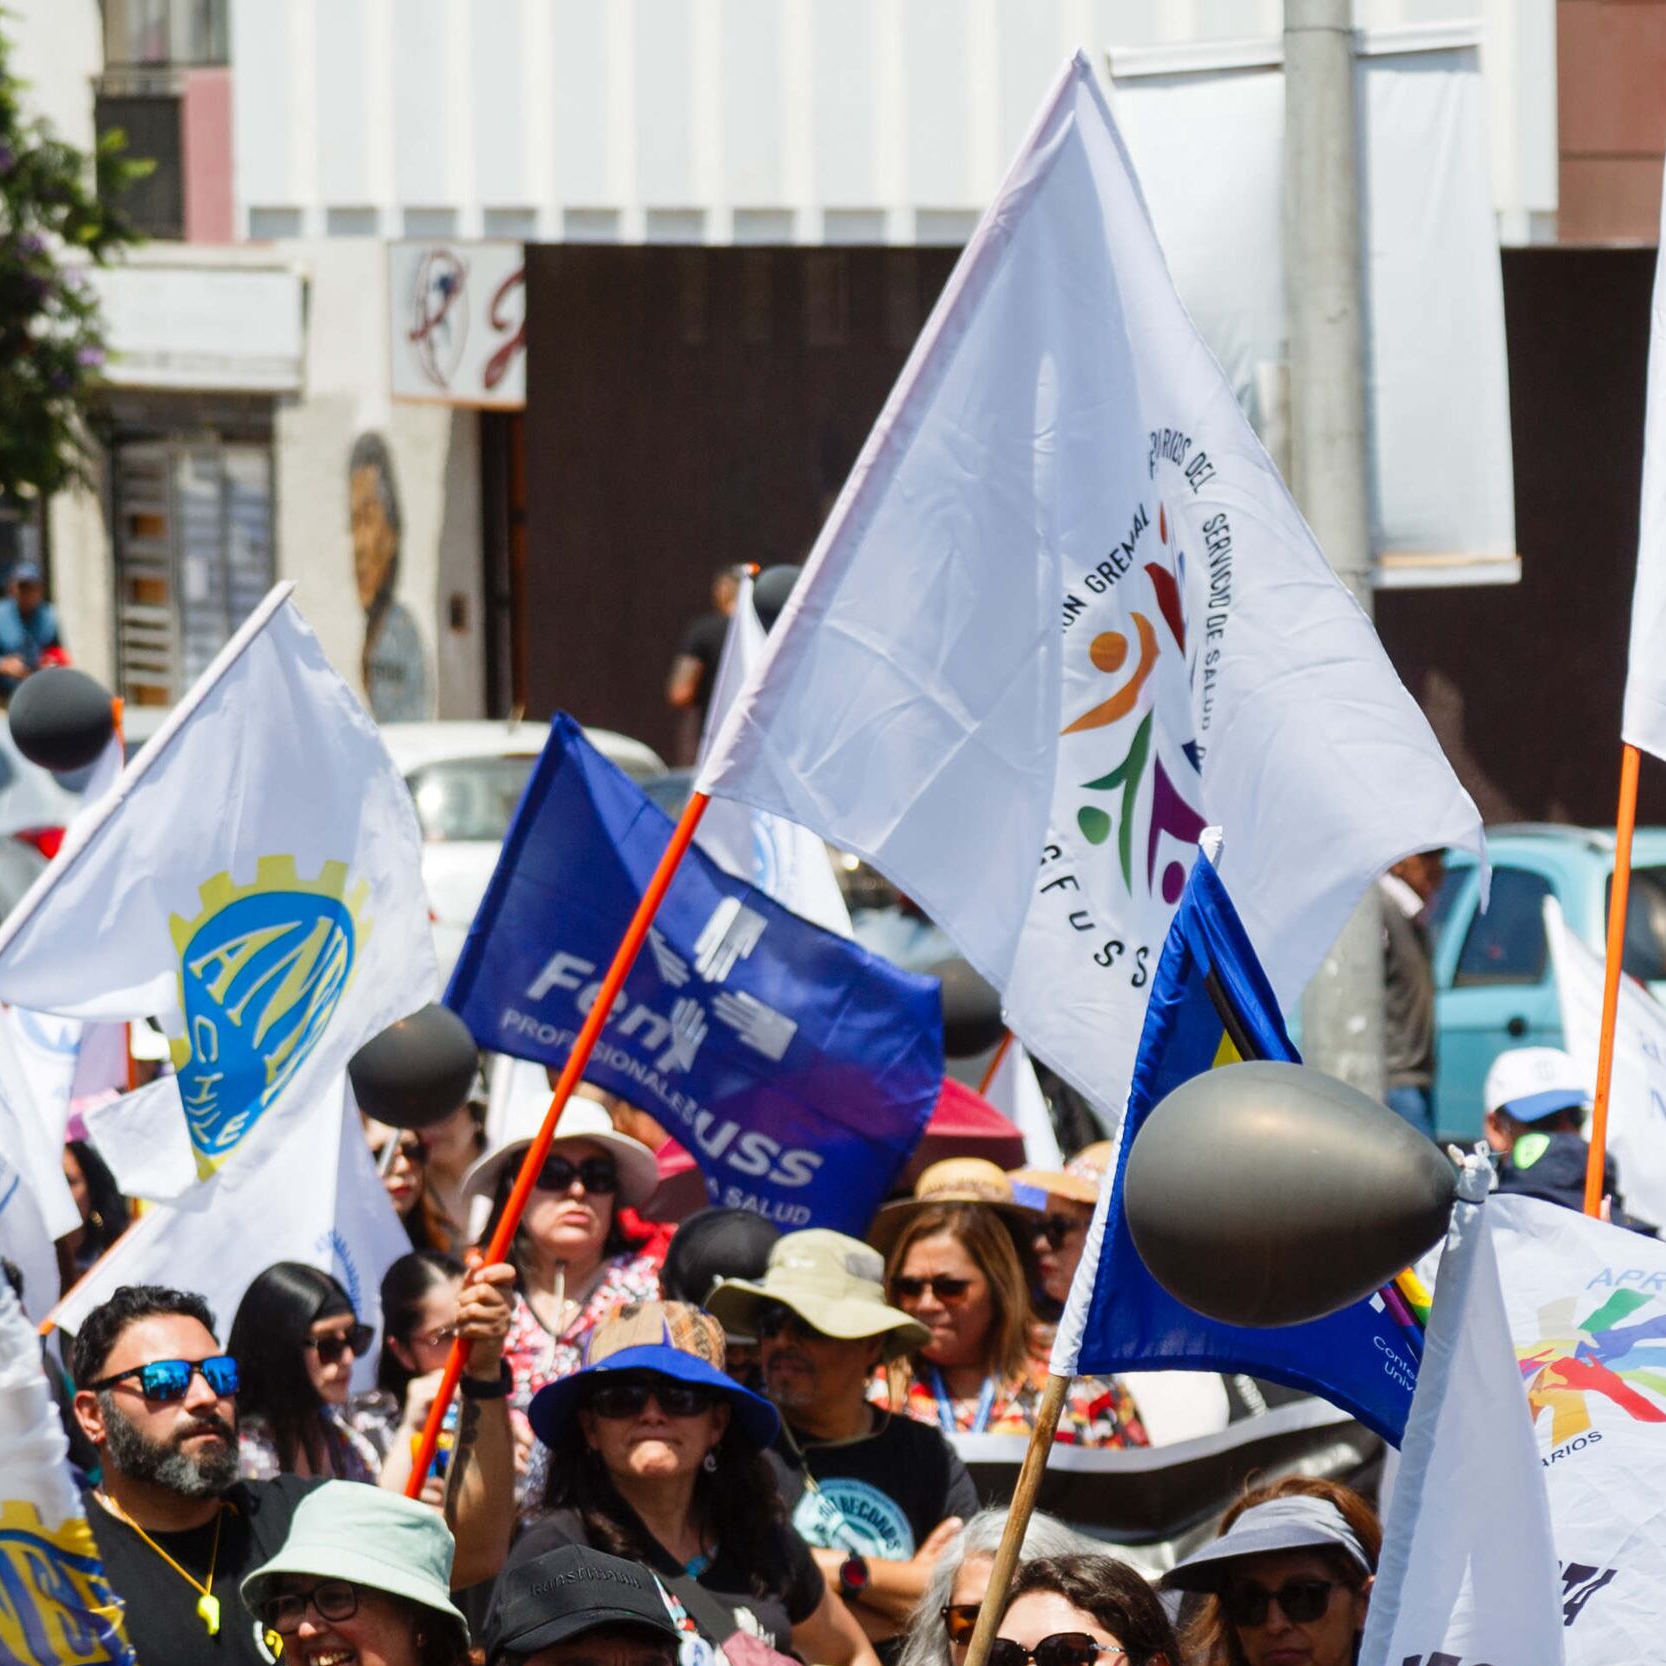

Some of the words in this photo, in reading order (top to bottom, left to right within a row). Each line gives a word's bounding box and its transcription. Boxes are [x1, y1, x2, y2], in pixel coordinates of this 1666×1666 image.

[1184, 451, 1216, 495] DEL
[1202, 512, 1233, 609] SERVICIO
[1205, 613, 1228, 640] DE
[725, 1185, 811, 1227] SALUD
